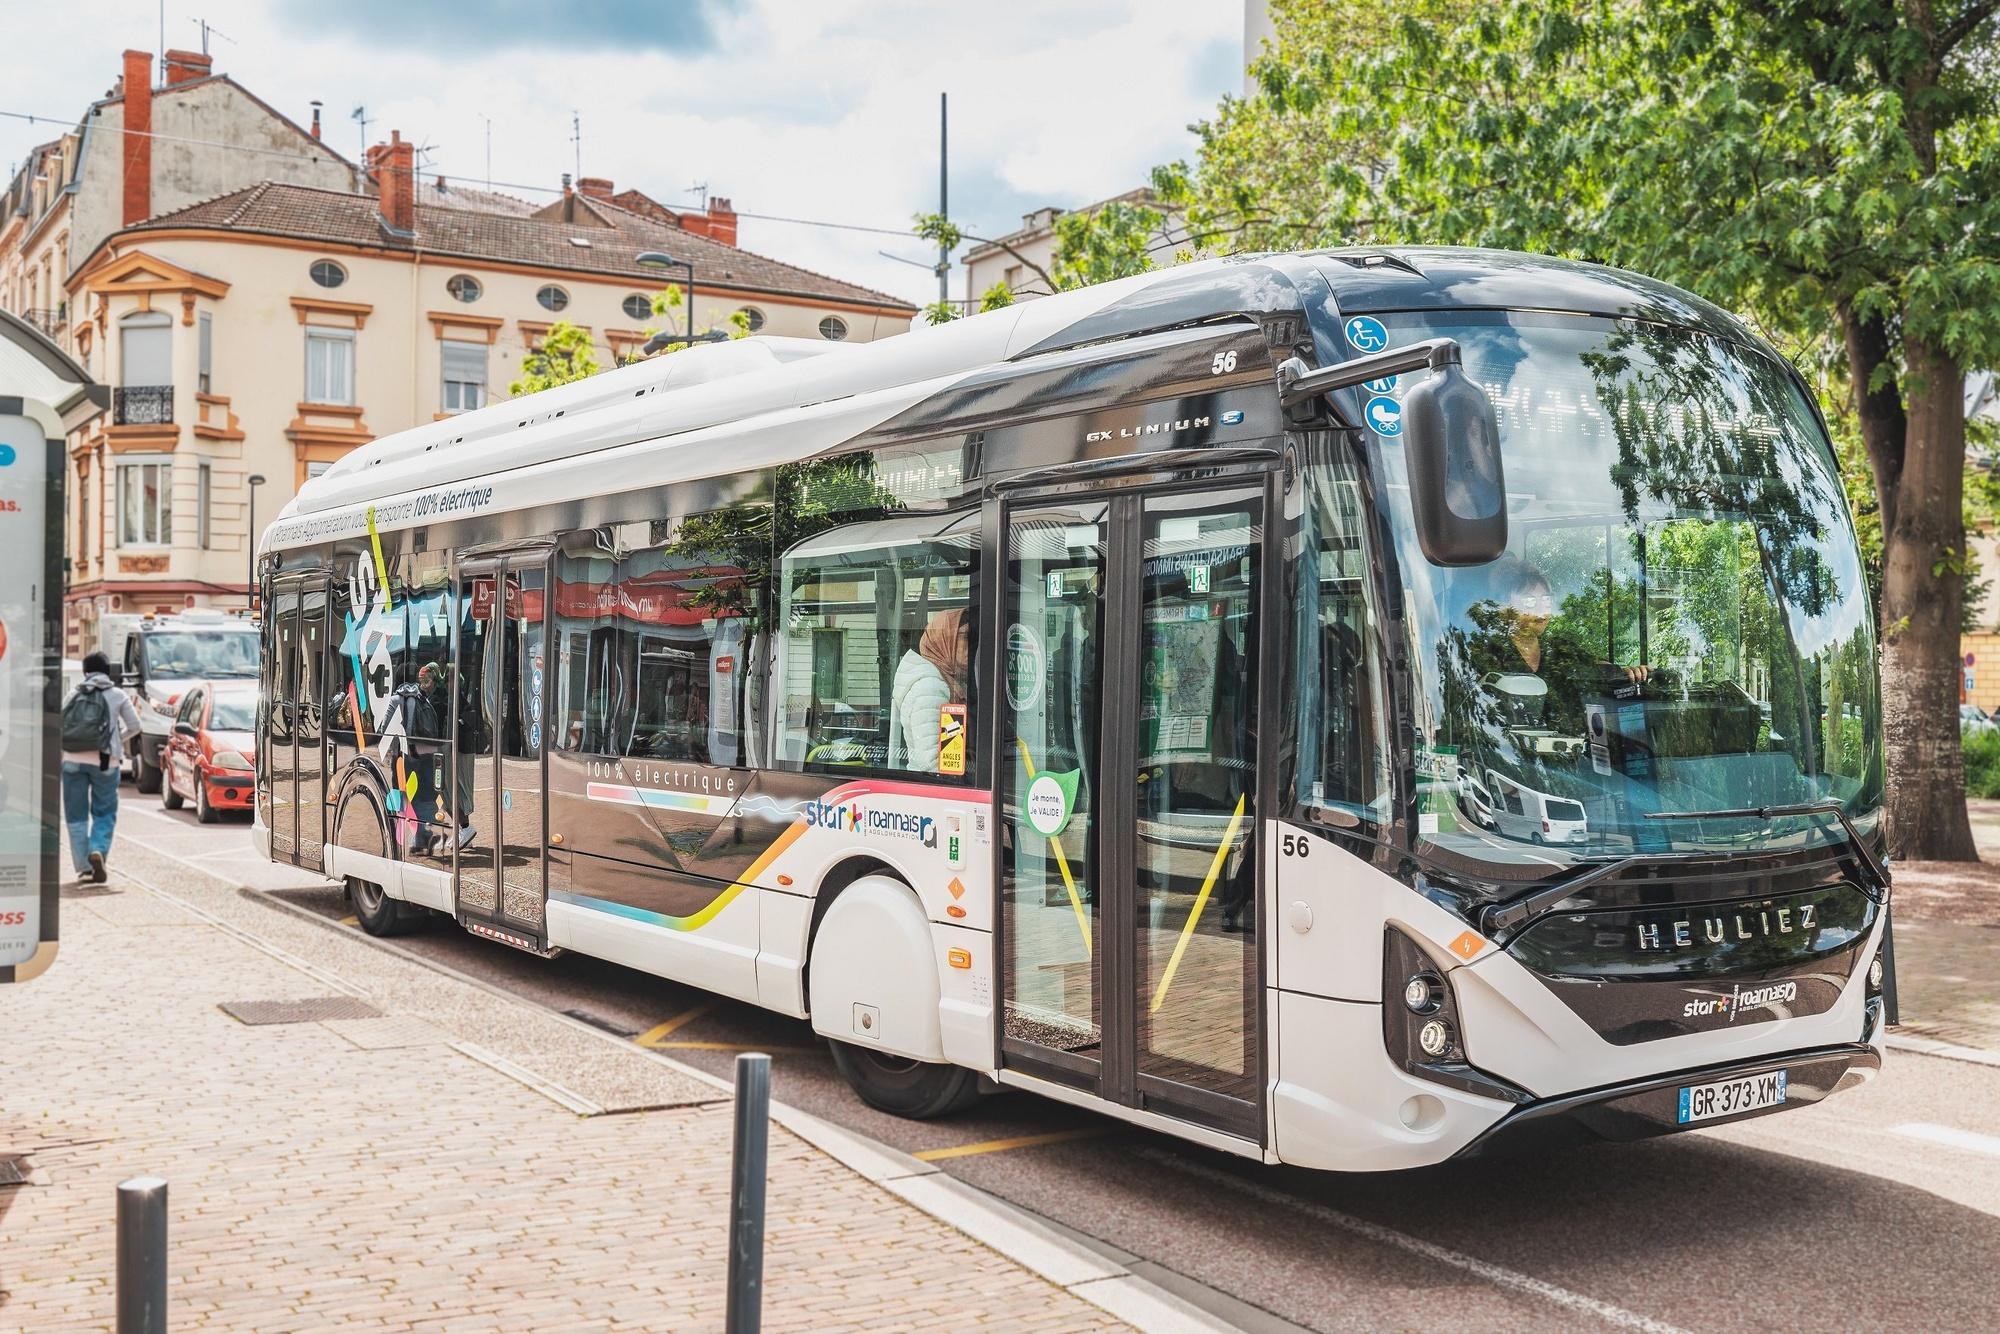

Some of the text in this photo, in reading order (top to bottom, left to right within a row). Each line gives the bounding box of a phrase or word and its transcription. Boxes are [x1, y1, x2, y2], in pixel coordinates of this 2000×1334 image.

[1211, 350, 1238, 375] 56
[1086, 430, 1113, 443] GX
[1120, 416, 1210, 439] LINIUM
[413, 492, 440, 517] 100%
[439, 484, 493, 513] électrique
[942, 753, 961, 761] ANGLES
[942, 761, 960, 769] MORTS
[586, 761, 735, 795] 100% électrique
[1032, 793, 1040, 802] Je
[806, 797, 847, 830] star
[868, 809, 919, 834] roannais
[1030, 806, 1038, 815] Je
[1039, 807, 1059, 817] VALIDE
[1282, 834, 1310, 858] 56
[1638, 904, 1816, 950] HEULIEZ
[1683, 998, 1718, 1018] star
[1739, 983, 1786, 1007] roannais
